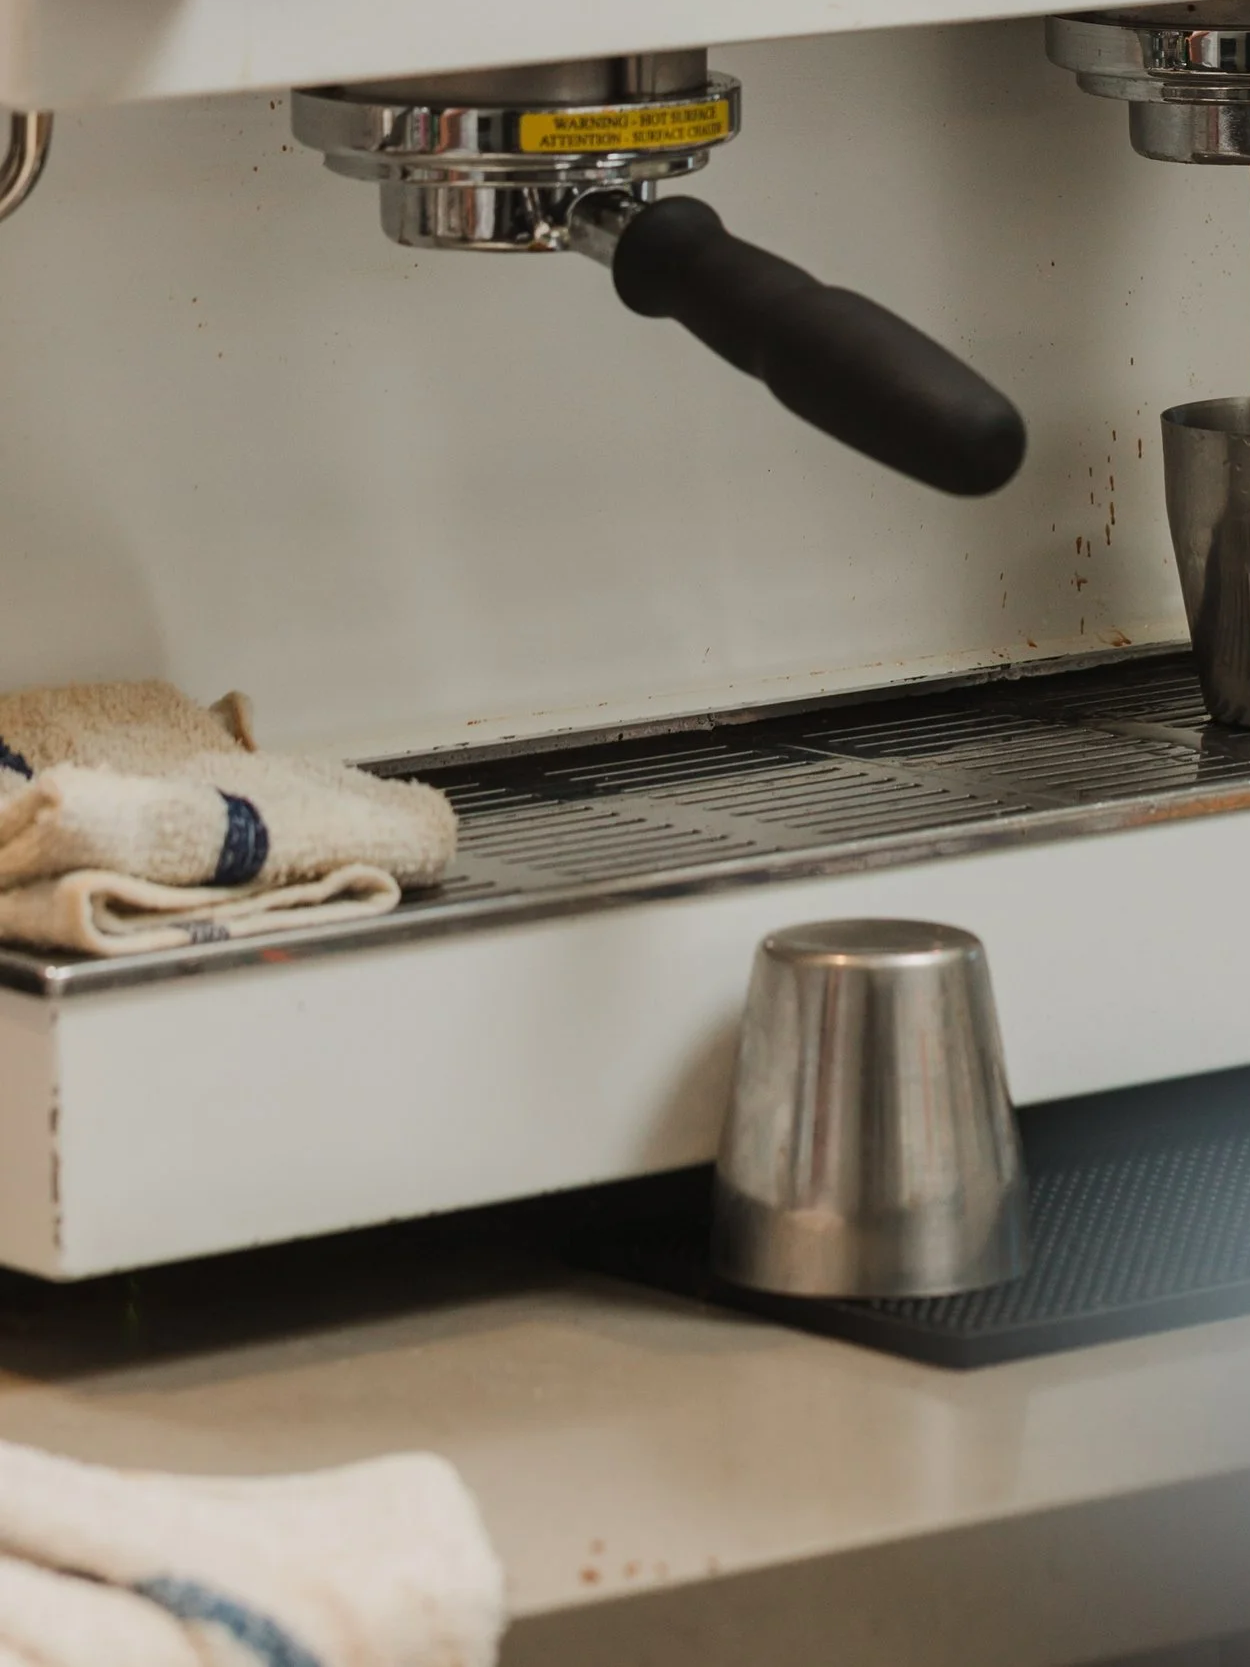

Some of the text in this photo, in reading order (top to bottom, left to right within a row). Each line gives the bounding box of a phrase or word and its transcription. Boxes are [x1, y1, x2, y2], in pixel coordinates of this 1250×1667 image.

[553, 115, 628, 131] WARNING
[640, 113, 668, 127] HOT
[539, 133, 621, 148] ATTENTION
